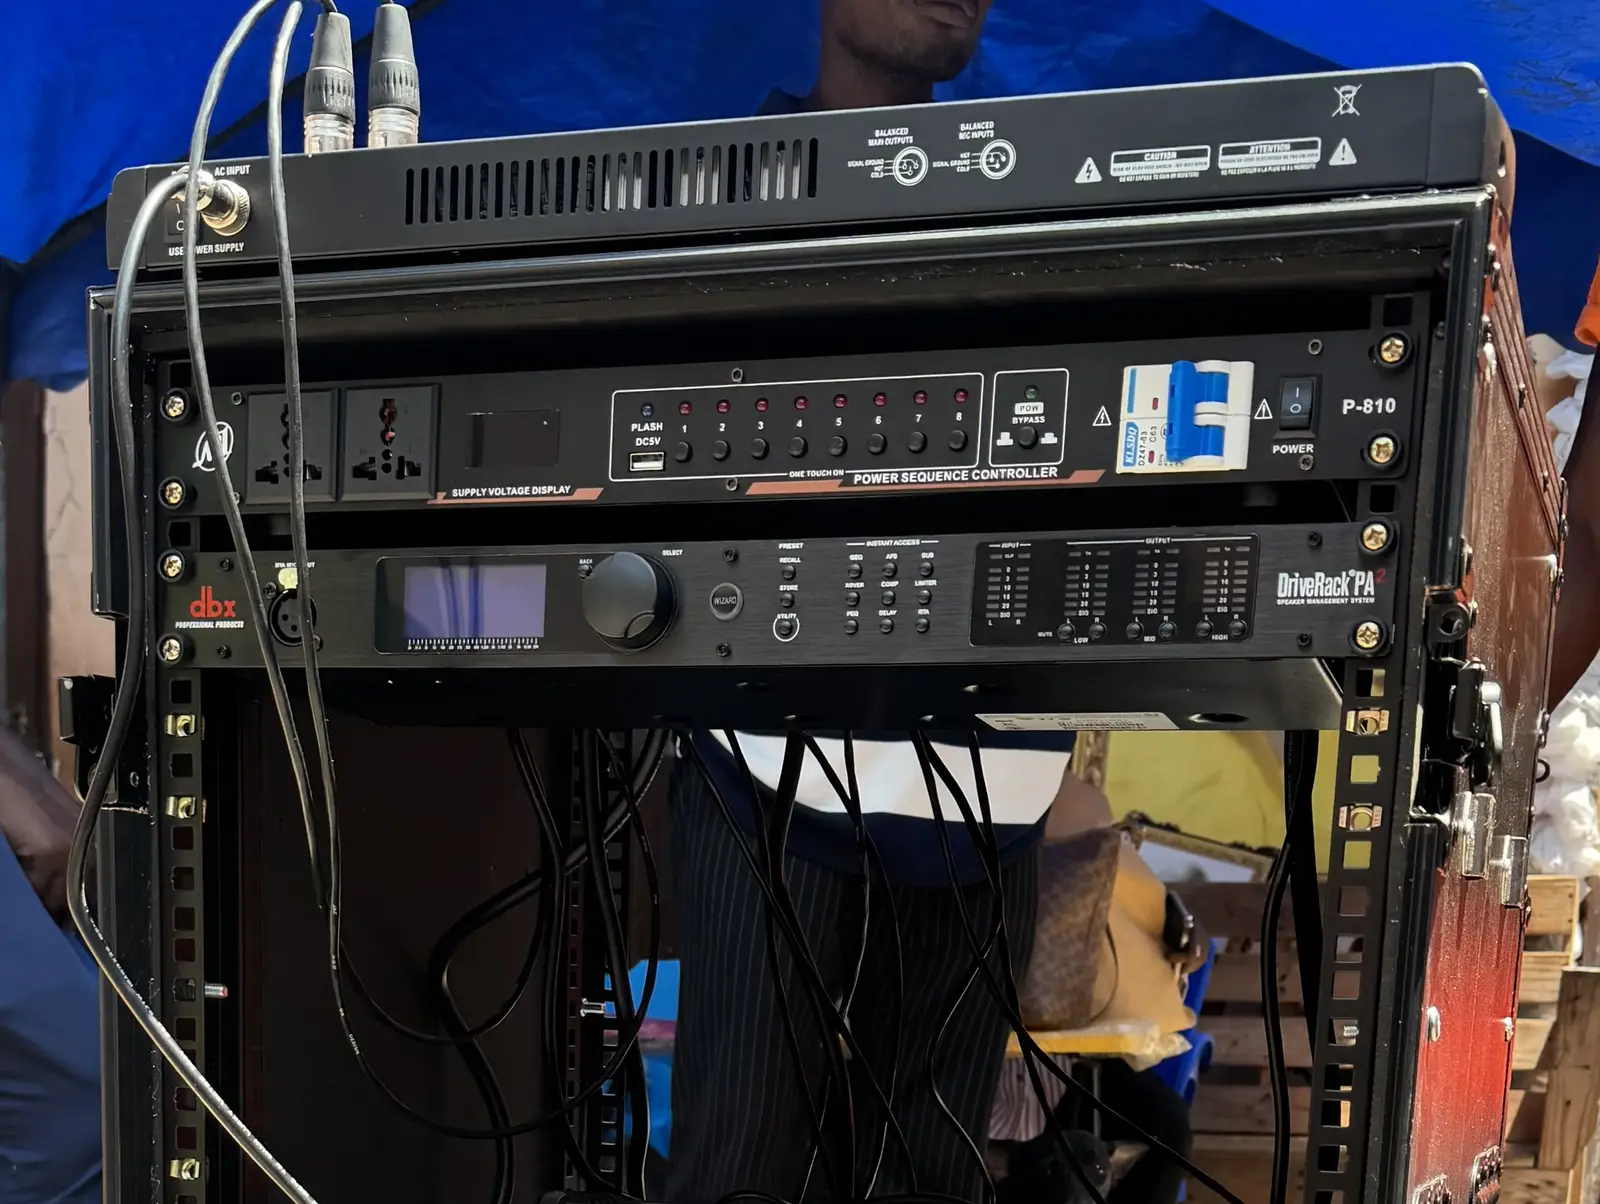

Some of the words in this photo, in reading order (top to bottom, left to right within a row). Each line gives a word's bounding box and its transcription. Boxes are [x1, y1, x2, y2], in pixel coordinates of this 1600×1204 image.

[960, 121, 994, 131] BALANCED
[875, 128, 909, 138] BALANCED
[886, 136, 914, 145] OUTPUTS
[1249, 144, 1291, 155] ATTENTION
[1144, 152, 1177, 161] CAUTION
[215, 167, 225, 177] AC
[227, 165, 251, 176] INPUT
[215, 242, 245, 253] SUPPLY
[1342, 398, 1396, 415] P-810
[876, 416, 882, 425] 6
[916, 414, 922, 423] 7
[956, 412, 962, 421] 8
[1012, 416, 1046, 425] BYPASS
[758, 421, 764, 430] 3
[796, 419, 803, 428] 4
[836, 417, 842, 426] 5
[631, 422, 663, 432] PLASH
[682, 424, 687, 433] 1
[719, 423, 726, 432] 2
[635, 437, 661, 447] DC5V
[1273, 444, 1315, 454] POWER
[789, 470, 805, 478] ONE
[854, 472, 899, 485] POWER
[901, 470, 969, 483] SEQUENCE
[972, 466, 1058, 480] CONTROLLER
[452, 488, 486, 497] SUPPLY
[488, 486, 530, 496] VOLTAGE
[532, 485, 571, 495] DISPLAY
[778, 542, 804, 550] PRESET
[779, 584, 799, 592] STORE
[881, 580, 899, 588] COMP
[189, 586, 237, 618] dbx
[714, 596, 737, 605] WIZARD
[1276, 598, 1305, 606] SPEAKER
[175, 621, 215, 629] PROFESSIONAL
[215, 621, 245, 629] PRODUCTS
